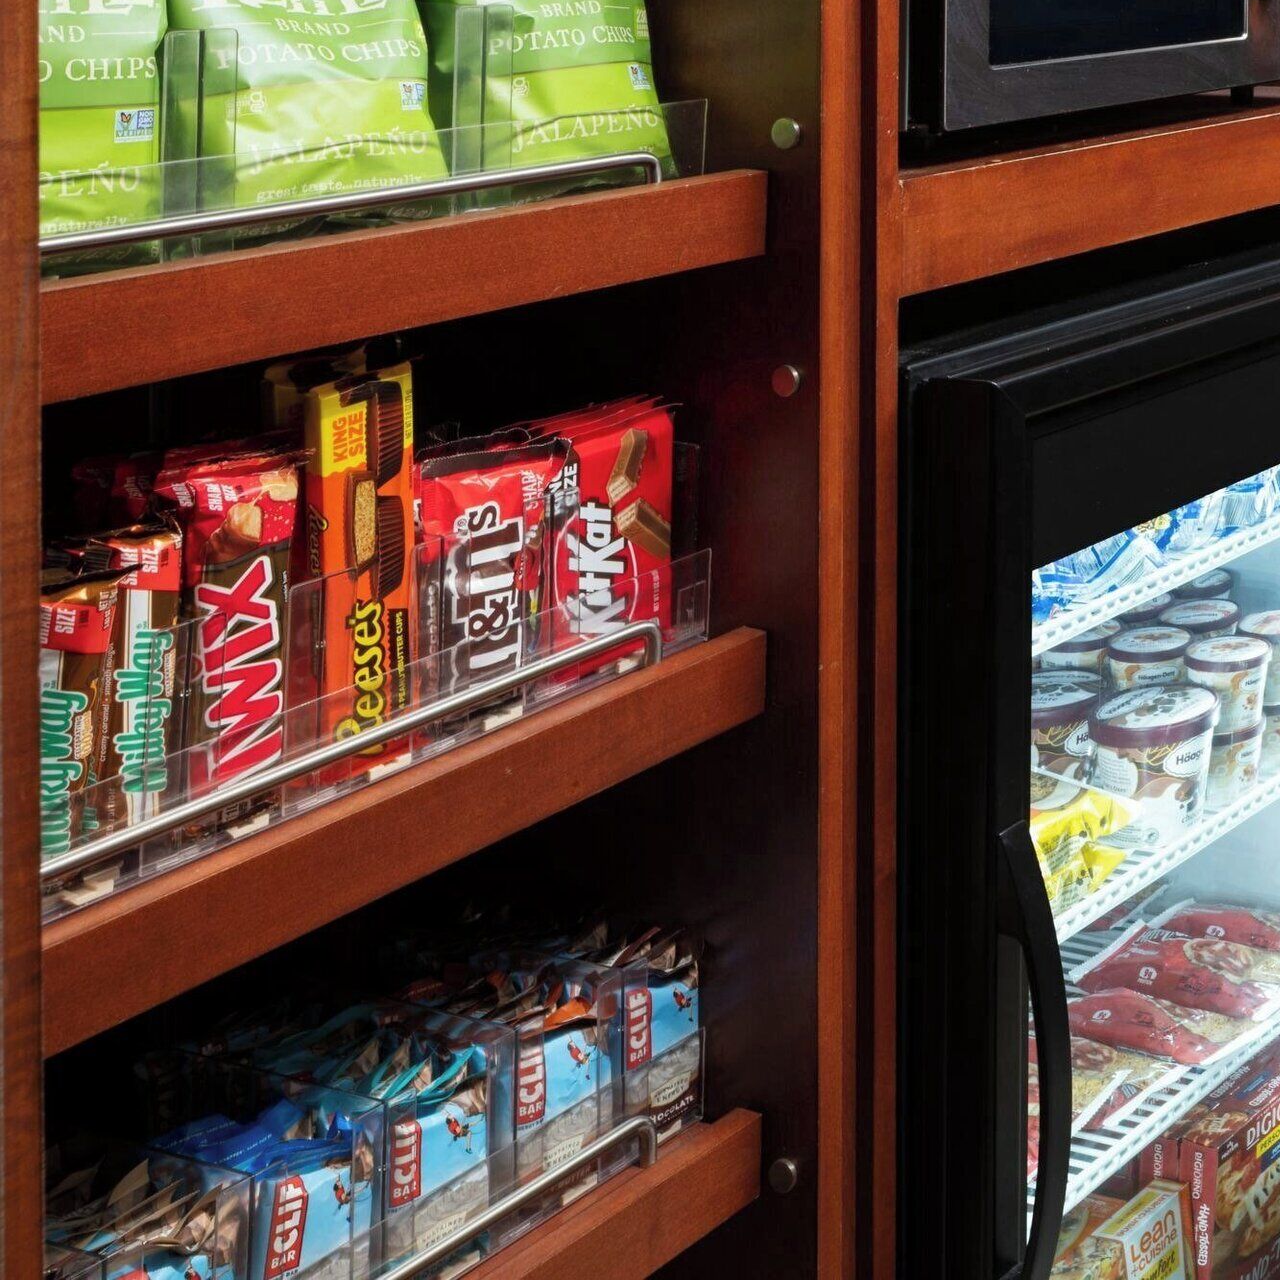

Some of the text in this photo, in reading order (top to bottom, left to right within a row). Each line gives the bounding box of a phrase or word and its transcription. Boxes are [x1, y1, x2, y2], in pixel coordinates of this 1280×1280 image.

[540, 0, 601, 18] BRAND
[275, 18, 350, 38] BRAND
[487, 25, 636, 56] POTATO CHIPS
[65, 56, 157, 82] CHIPS
[213, 38, 422, 70] POTATO CHIPS
[511, 104, 660, 153] JALAPEÑO
[248, 126, 429, 175] JALAPEÑO
[333, 410, 364, 463] KING SIZE
[205, 483, 224, 512] SHARE
[141, 546, 159, 575] SIZE
[55, 608, 77, 634] SIZE
[397, 611, 405, 633] CUPS
[396, 634, 405, 669] BUTTER
[186, 554, 284, 796] TWIX
[335, 598, 387, 756] Reese's
[115, 628, 175, 794] Milky Way
[630, 990, 649, 1050] CLIF
[519, 1101, 543, 1118] BAR
[650, 1094, 697, 1124] HOCOLATE
[394, 1121, 417, 1185] CLIF
[1192, 1152, 1203, 1200] DIGIORNO
[272, 1180, 304, 1255] CLIF
[1197, 1203, 1211, 1267] HAND-TOSSED
[1131, 1208, 1177, 1264] Lean
[270, 1249, 296, 1270] BAR
